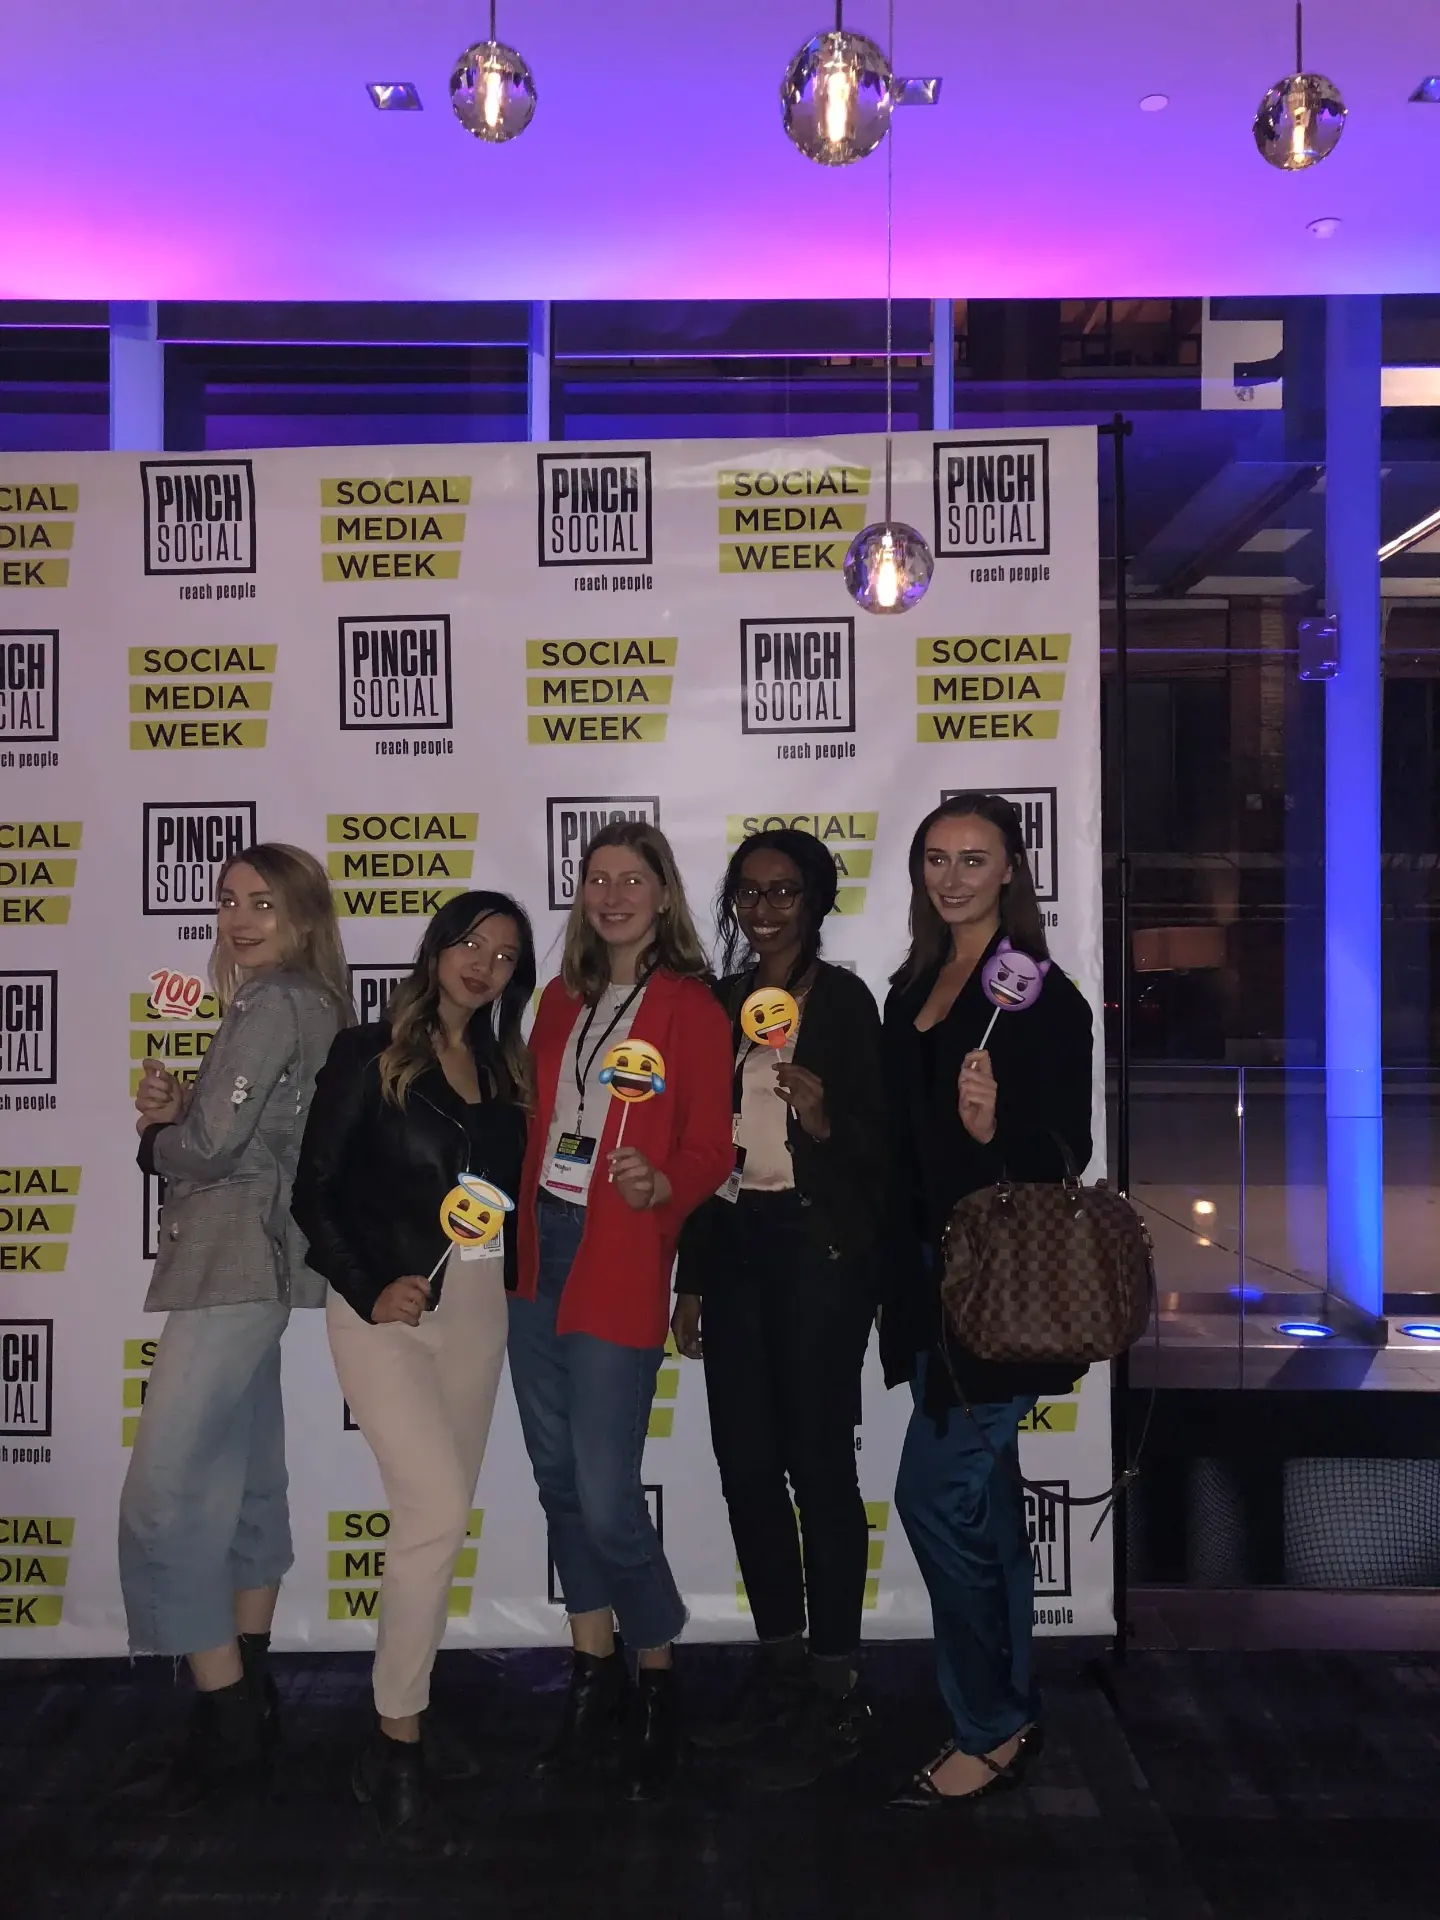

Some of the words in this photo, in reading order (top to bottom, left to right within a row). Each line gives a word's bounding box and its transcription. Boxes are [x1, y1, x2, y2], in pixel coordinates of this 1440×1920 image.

[552, 467, 638, 514] PINCH
[735, 470, 859, 496] SOCIAL
[948, 454, 1035, 503] PINCH
[0, 487, 67, 511] CIAL
[156, 474, 242, 523] PINCH
[337, 480, 459, 504] SOCIAL
[338, 517, 442, 540] MEDIA
[736, 507, 842, 531] MEDIA
[949, 504, 1036, 544] SOCIAL
[0, 525, 51, 548] DIA
[157, 522, 242, 563] SOCIAL
[552, 514, 638, 553] SOCIAL
[337, 554, 435, 578] WEEK
[735, 544, 834, 570] WEEK
[4, 562, 44, 585] EK
[575, 575, 607, 591] reach
[613, 574, 652, 592] people
[971, 566, 1004, 582] reach
[1010, 564, 1049, 583] people
[180, 584, 212, 599] reach
[217, 582, 255, 600] people
[145, 648, 265, 672] SOCIAL
[353, 630, 437, 677] PINCH
[542, 641, 665, 666] SOCIAL
[755, 632, 841, 680] PINCH
[933, 638, 1058, 663] SOCIAL
[146, 685, 249, 710] MEDIA
[354, 678, 439, 717] SOCIAL
[544, 679, 648, 703] MEDIA
[934, 676, 1040, 701] MEDIA
[756, 681, 841, 721] SOCIAL
[146, 723, 242, 747] WEEK
[544, 717, 641, 741] WEEK
[933, 714, 1033, 739] WEEK
[376, 739, 408, 754] reach
[414, 738, 453, 756] people
[778, 743, 810, 759] reach
[816, 741, 855, 761] people
[20, 751, 58, 768] people
[0, 825, 70, 848] CIAL
[157, 816, 243, 862] PINCH
[343, 816, 466, 840] SOCIAL
[0, 862, 53, 885] DIA
[345, 853, 449, 878] MEDIA
[157, 864, 212, 902] SOCI
[4, 899, 44, 922] EK
[344, 890, 442, 915] WEEK
[179, 924, 211, 940] reach
[151, 970, 201, 1006] 100
[147, 1032, 214, 1056] MED
[16, 1093, 56, 1111] people
[0, 1170, 68, 1193] CIAL
[0, 1208, 49, 1231] DIA
[1, 1246, 41, 1269] EK
[13, 1446, 50, 1464] people
[0, 1558, 46, 1582] DIA
[0, 1598, 37, 1623] EK
